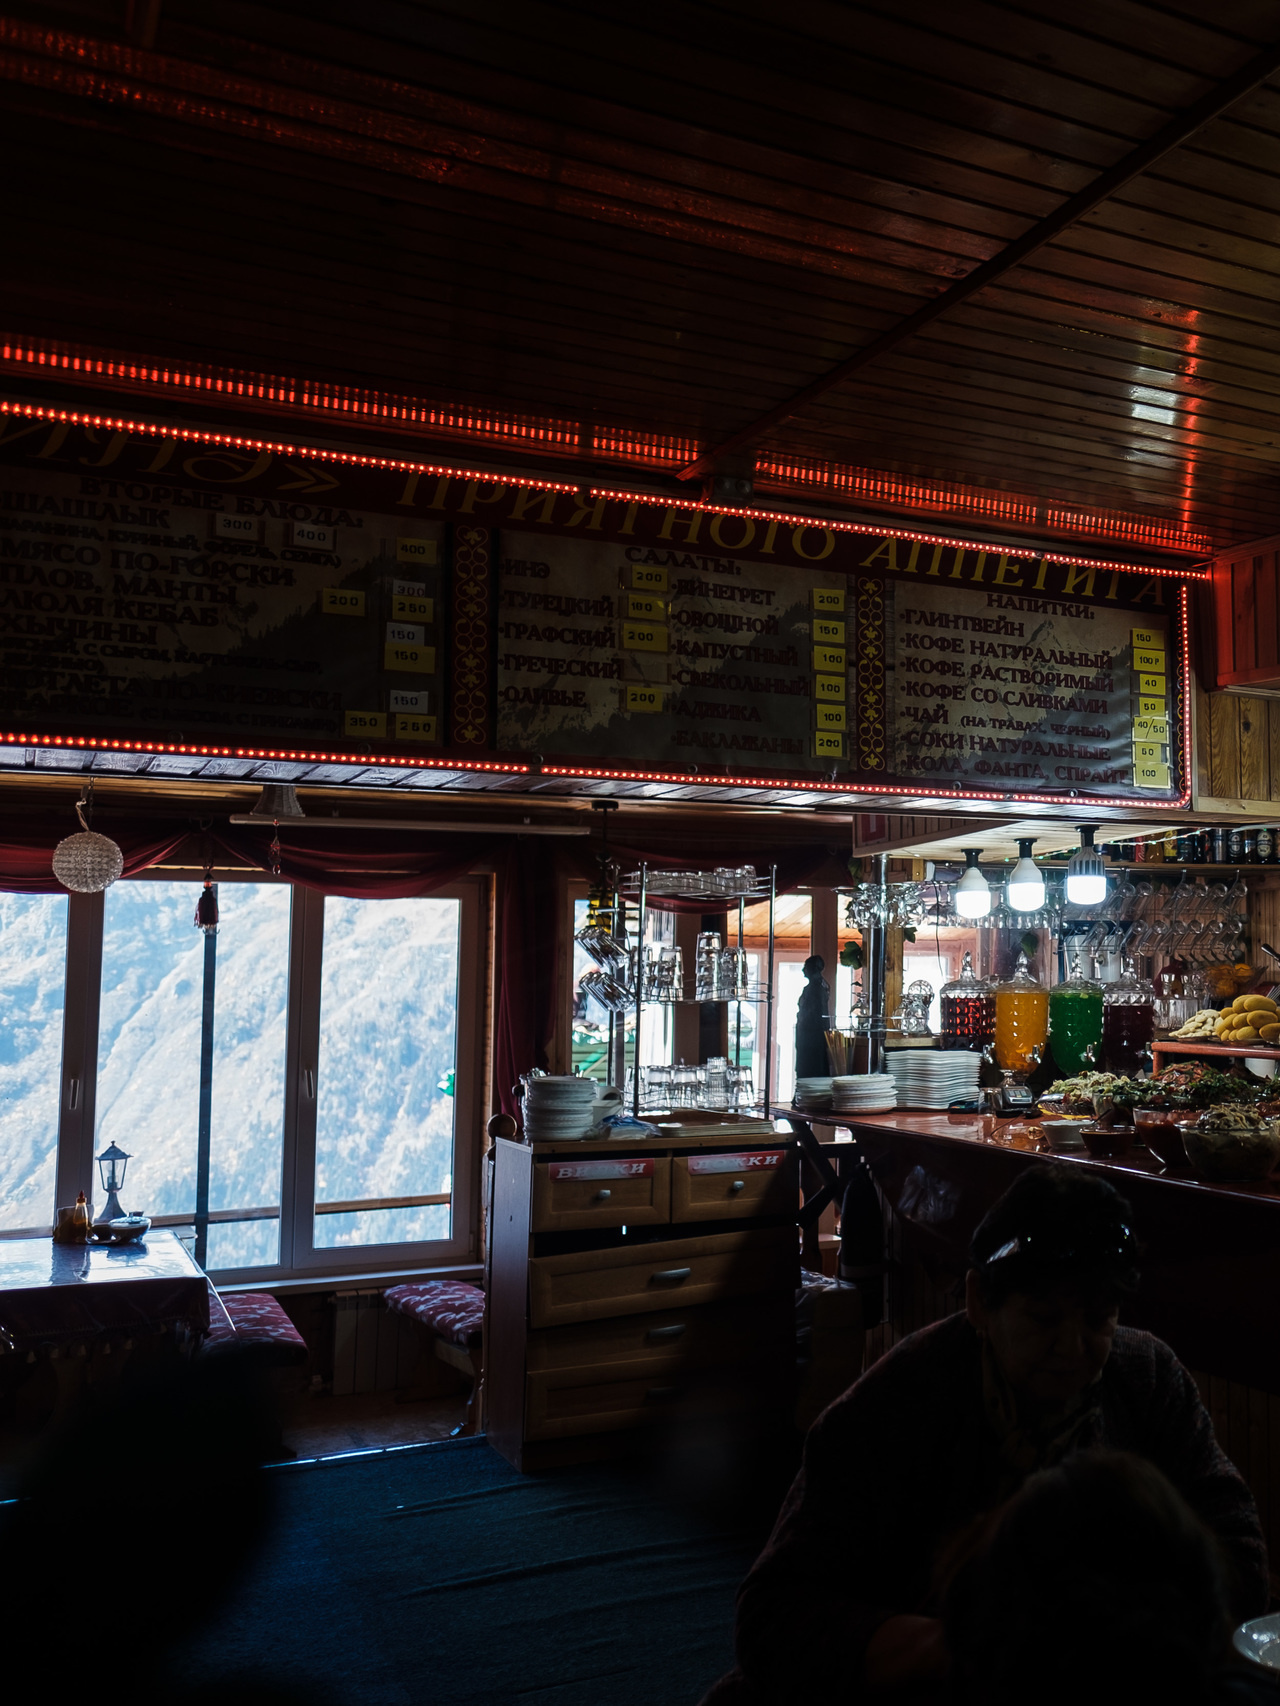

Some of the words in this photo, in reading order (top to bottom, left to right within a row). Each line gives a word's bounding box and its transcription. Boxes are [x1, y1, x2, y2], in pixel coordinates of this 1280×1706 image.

[79, 476, 225, 511] ВТОРЫЕ
[235, 496, 364, 528] БЛЮДА:
[222, 518, 253, 531] 300
[297, 529, 327, 542] 400
[395, 471, 836, 560] ПРИЯТНОГО
[858, 536, 1166, 606] АППЕТИТА
[400, 543, 426, 555] 400
[0, 538, 101, 566] МЯСО
[110, 549, 295, 586] ПО-ГОРСКИ
[505, 559, 551, 579] ИНЭ
[624, 547, 742, 576] САЛАТЫ:
[0, 562, 103, 594] ПЛОВ,
[113, 574, 237, 604] МАНТЫ
[636, 572, 662, 582] 200
[329, 594, 359, 606] 200
[677, 579, 775, 606] ВИНЕГРЕТ
[819, 595, 840, 605] 200
[0, 588, 105, 617] ЛЮЛЯ
[113, 599, 219, 627] КЕБАБ
[397, 602, 427, 614] 250
[504, 590, 614, 618] ТУРЕЦКИЙ
[987, 593, 1095, 620] НАПИТКИ:
[0, 613, 157, 645] ХЫЧИНЫ
[677, 610, 780, 636] ОВОЩНОЙ
[819, 626, 839, 635] 150
[905, 609, 1025, 637] ГЛИНТВЕЙН
[390, 629, 415, 641] 150
[504, 622, 616, 648] ГРАФСКИЙ
[628, 632, 654, 642] 200
[1136, 634, 1151, 643] 150
[394, 651, 418, 662] 150
[676, 640, 799, 667] КАПУСТНЫЙ
[823, 654, 843, 664] 100
[905, 633, 965, 654] КОФЕ
[970, 639, 1113, 670] НАТУРАЛЬНЫЙ
[1139, 656, 1153, 665] 100
[503, 654, 622, 680] ГРЕЧЕСКИЙ
[905, 657, 964, 678] КОФЕ
[970, 664, 1114, 693] РАСТВОРИМЫЙ
[676, 670, 809, 697] СВЕКОЛЬНЫЙ
[820, 684, 841, 693] 100
[1144, 679, 1157, 687] 40
[393, 696, 418, 706] 150
[504, 686, 587, 708] ОЛИВЬЕ
[630, 693, 655, 704] 200
[905, 681, 965, 702] КОФЕ
[971, 687, 998, 704] СО
[1002, 690, 1108, 715] СЛИВКАМИ
[1144, 703, 1156, 711] 50
[676, 700, 762, 722] АДЖИКА
[824, 713, 842, 722] 100
[350, 717, 378, 728] 350
[400, 721, 431, 733] 250
[904, 704, 948, 725] ЧАЙ
[960, 715, 988, 729] (НА
[989, 718, 1046, 735] ТРАВАХ,
[1051, 724, 1110, 740] ЧЕРНЫЙ)
[1137, 719, 1165, 739] 40/50
[676, 730, 804, 755] БАКЛАЖАНЫ
[818, 738, 840, 748] 200
[905, 731, 964, 751] СОКИ
[970, 736, 1111, 762] НАТУРАЛЬНЫЕ
[905, 755, 968, 776] КОЛА,
[974, 762, 1049, 781] ФАНТА,
[1054, 764, 1129, 785] СПРАЙТ
[1141, 768, 1156, 778] 100
